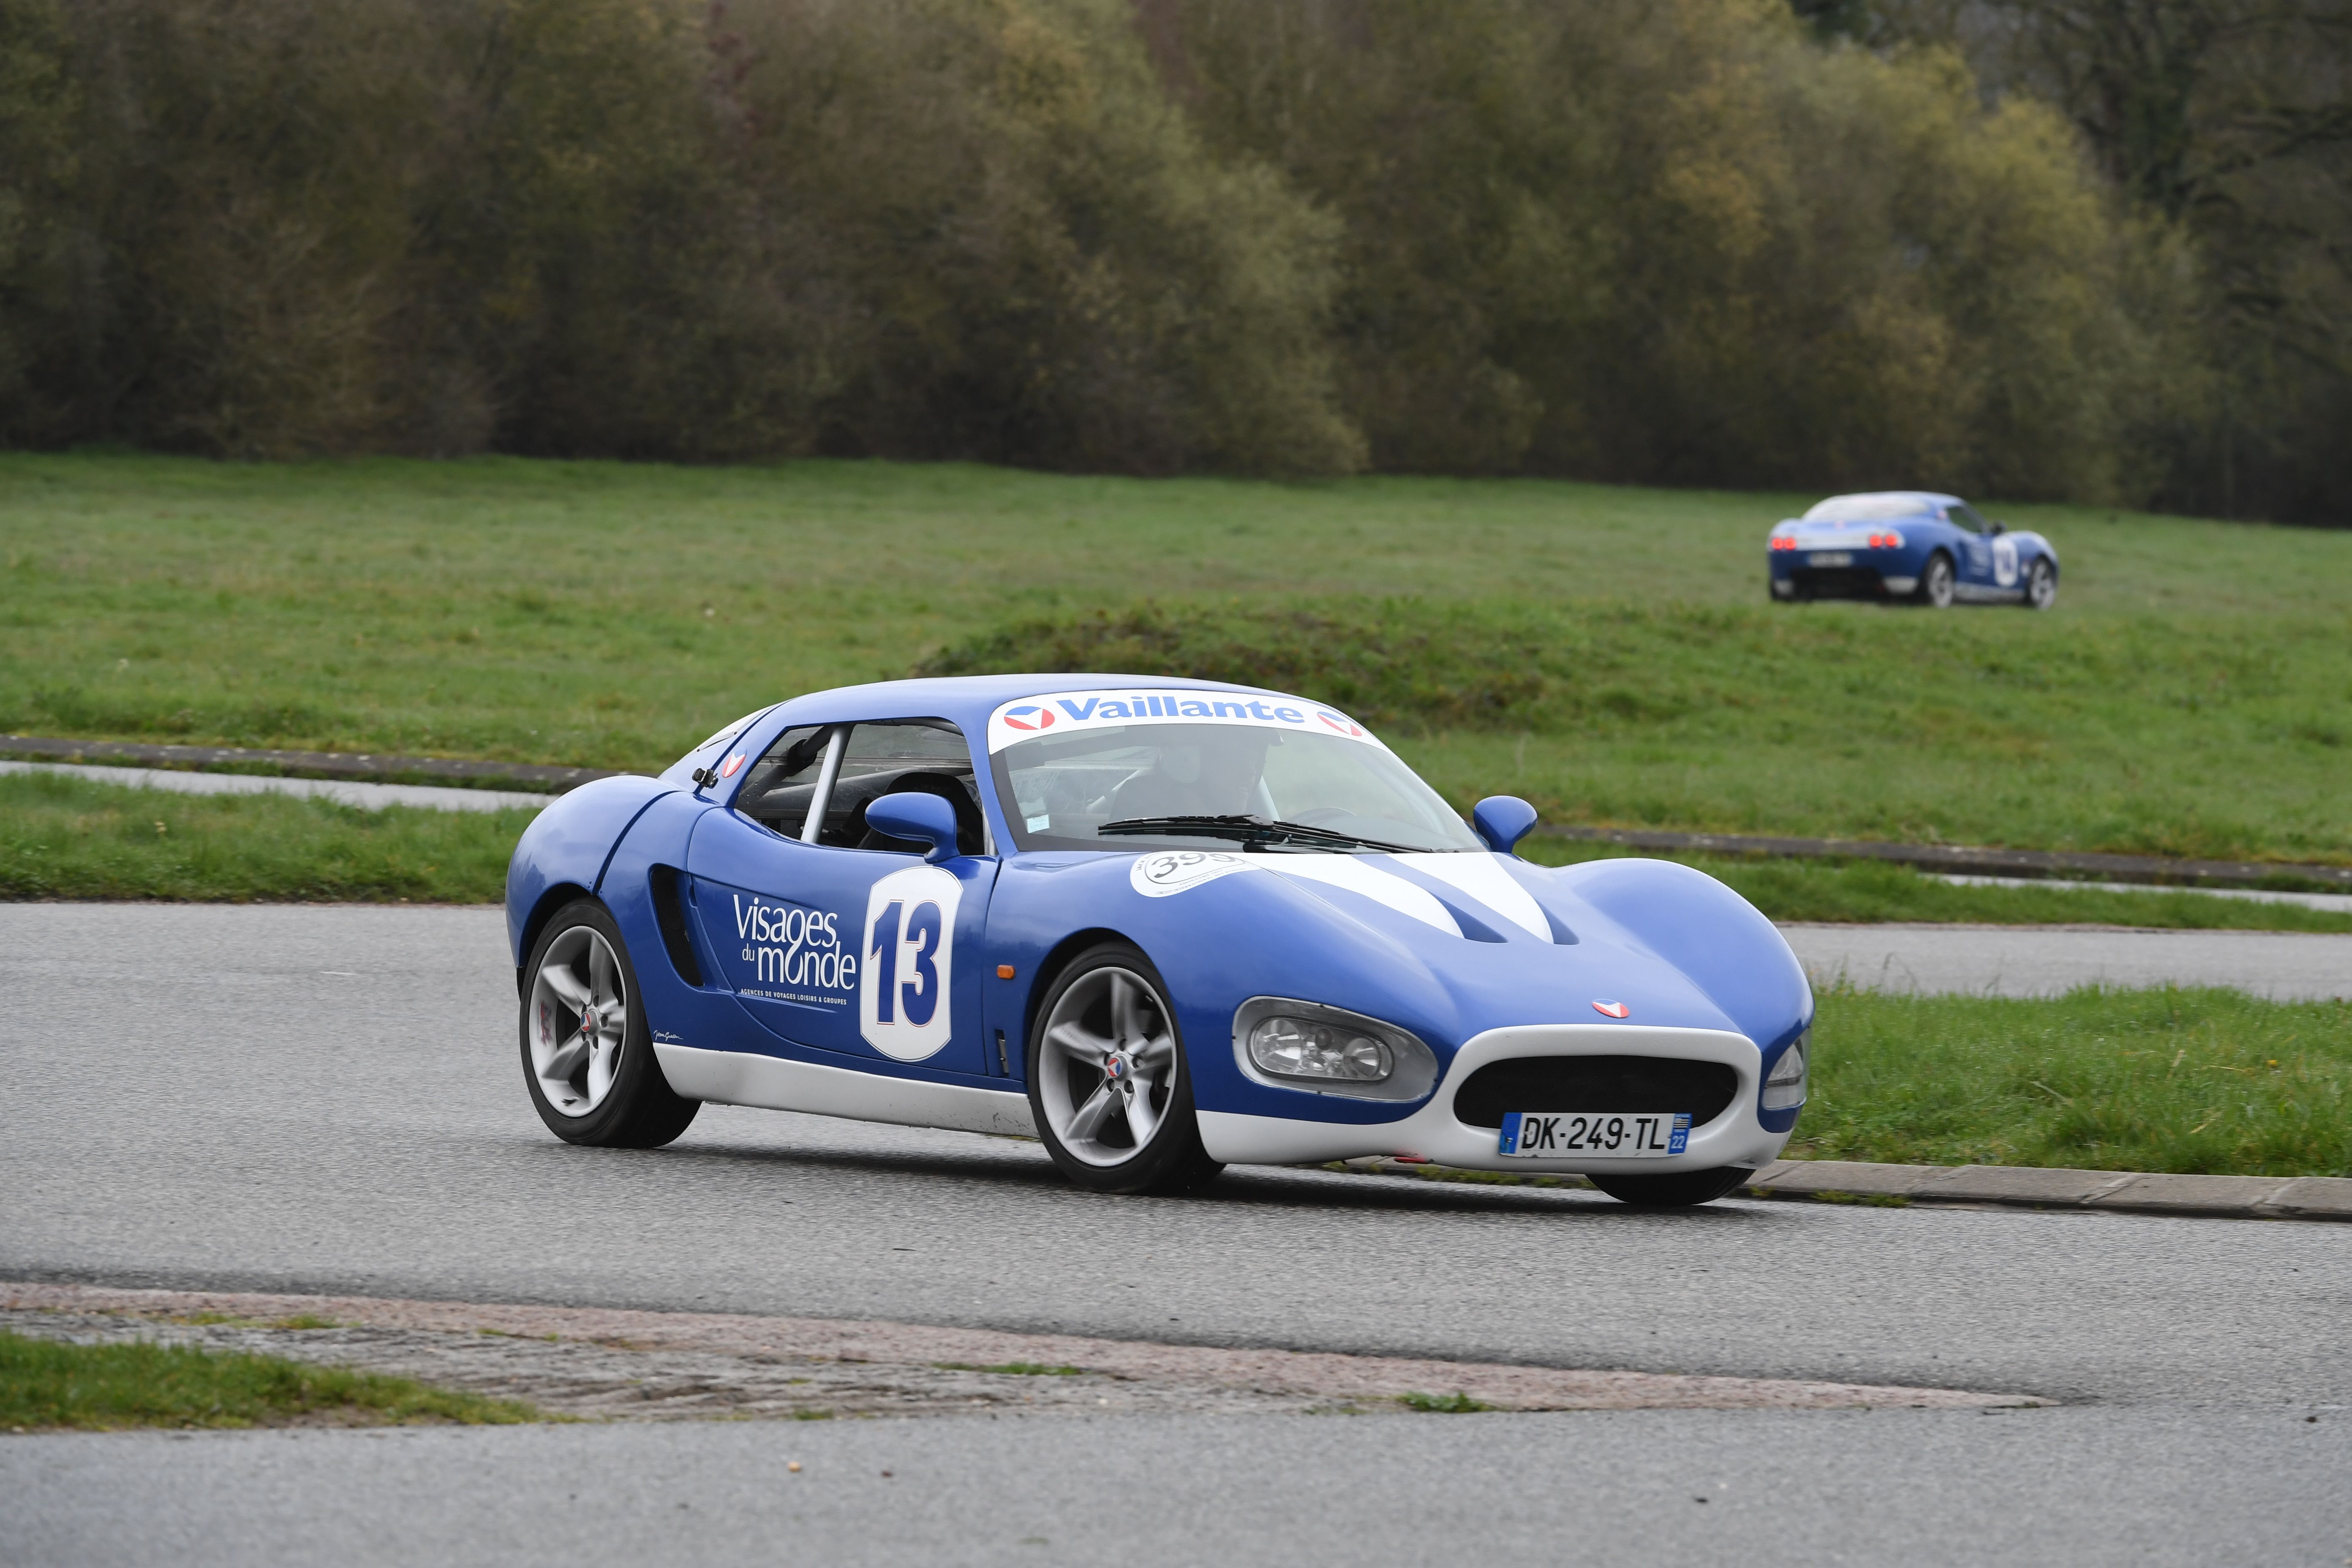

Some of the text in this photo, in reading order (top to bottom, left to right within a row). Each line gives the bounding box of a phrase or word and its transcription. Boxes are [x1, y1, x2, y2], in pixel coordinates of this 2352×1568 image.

[1056, 696, 1305, 723] Vaillante
[1152, 853, 1236, 878] 399
[733, 894, 838, 950] Visages
[742, 941, 856, 990] du monde
[870, 899, 942, 1028] 13
[740, 988, 764, 996] AGENCES
[773, 992, 796, 1000] VOYAGES
[797, 994, 817, 1002] LOISIRS
[823, 997, 847, 1005] GROUPES
[1521, 1117, 1665, 1149] DK-249-TL
[1671, 1135, 1685, 1149] 22
